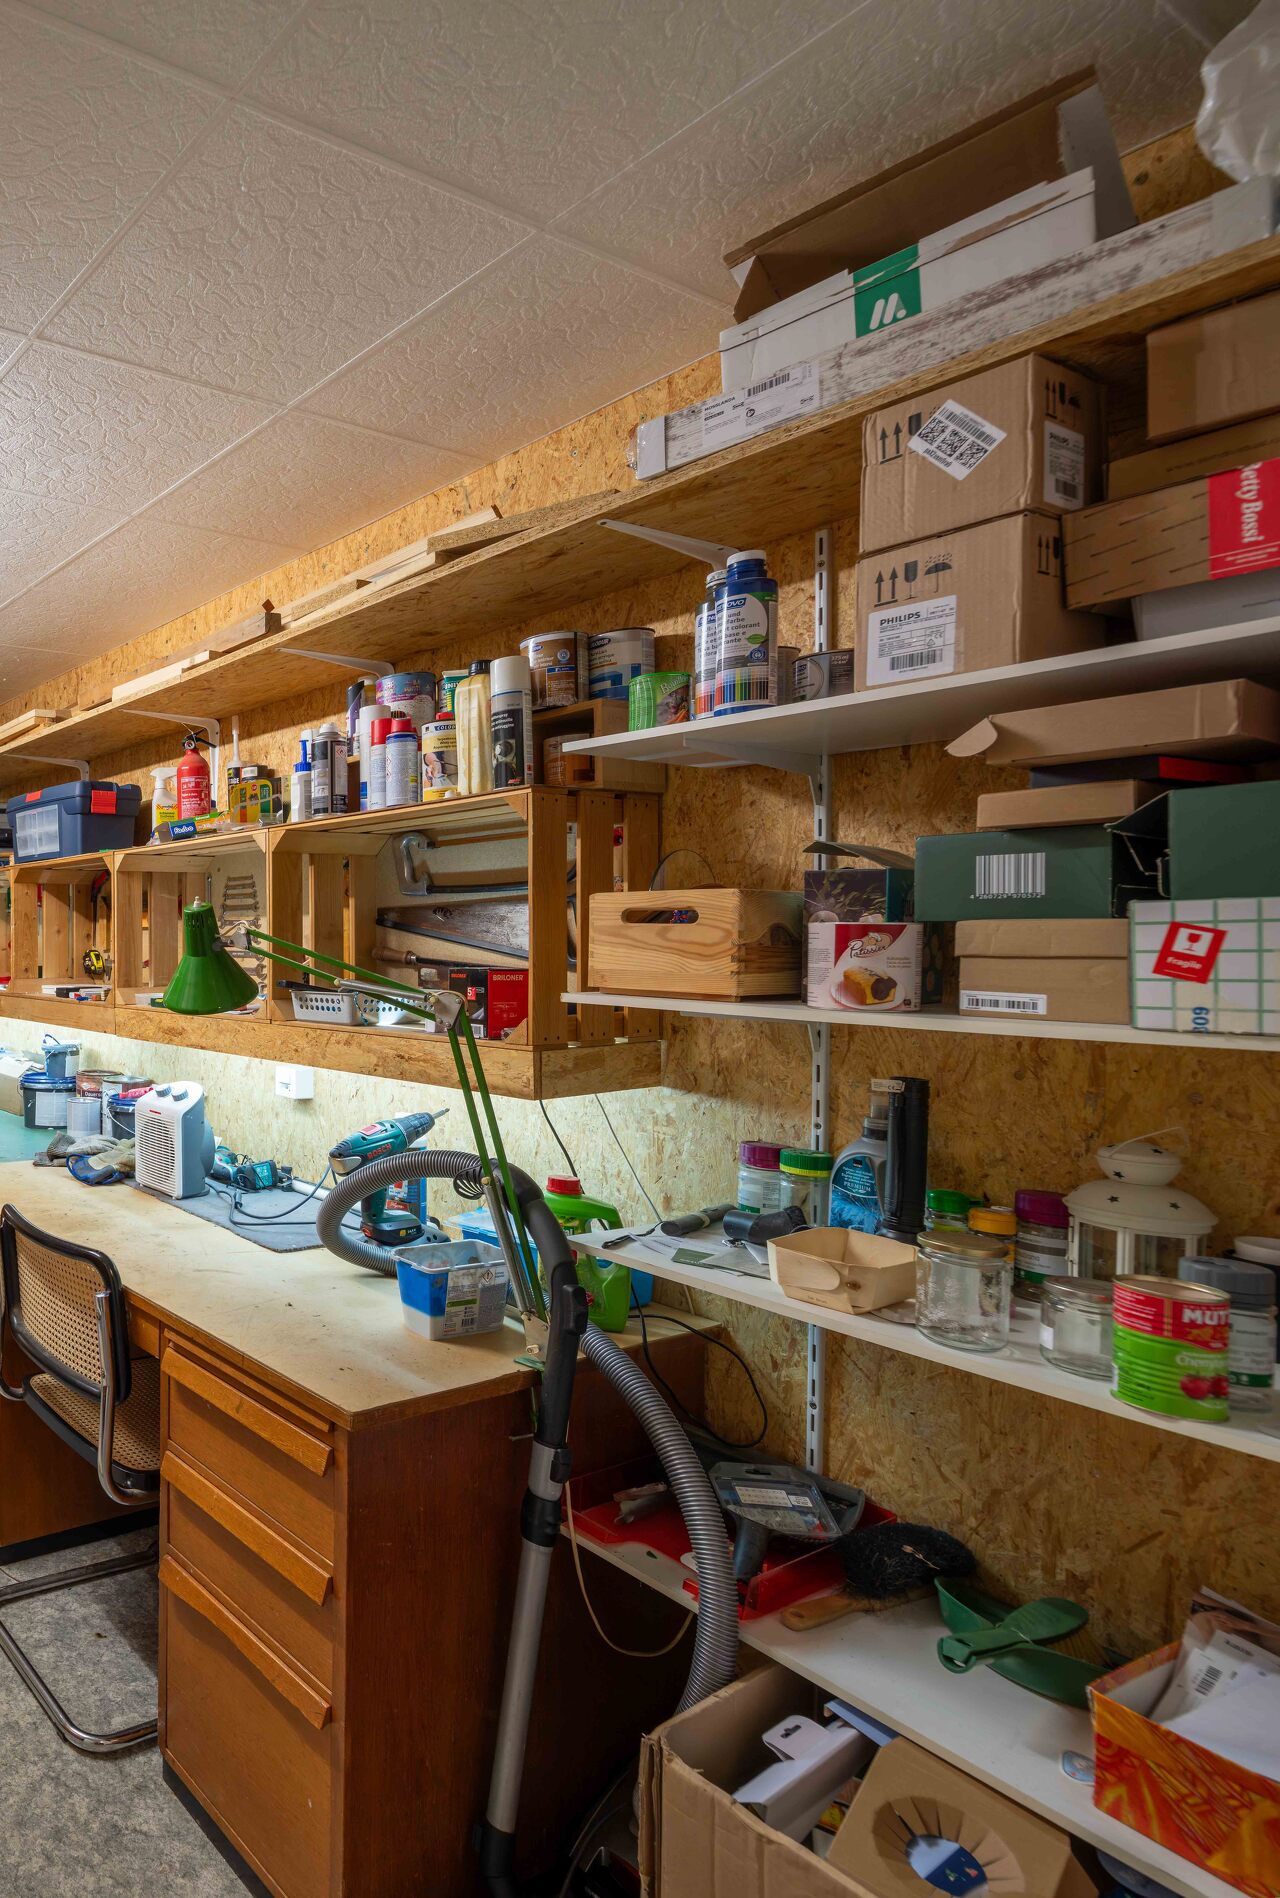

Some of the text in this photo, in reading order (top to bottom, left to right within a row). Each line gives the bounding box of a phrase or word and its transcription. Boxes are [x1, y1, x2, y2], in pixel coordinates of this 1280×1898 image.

[1235, 461, 1263, 500] etty
[880, 611, 921, 626] PHILIPS
[1166, 955, 1203, 970] Fragile
[367, 1143, 392, 1160] BOSCH
[844, 1181, 871, 1192] PREMIUM
